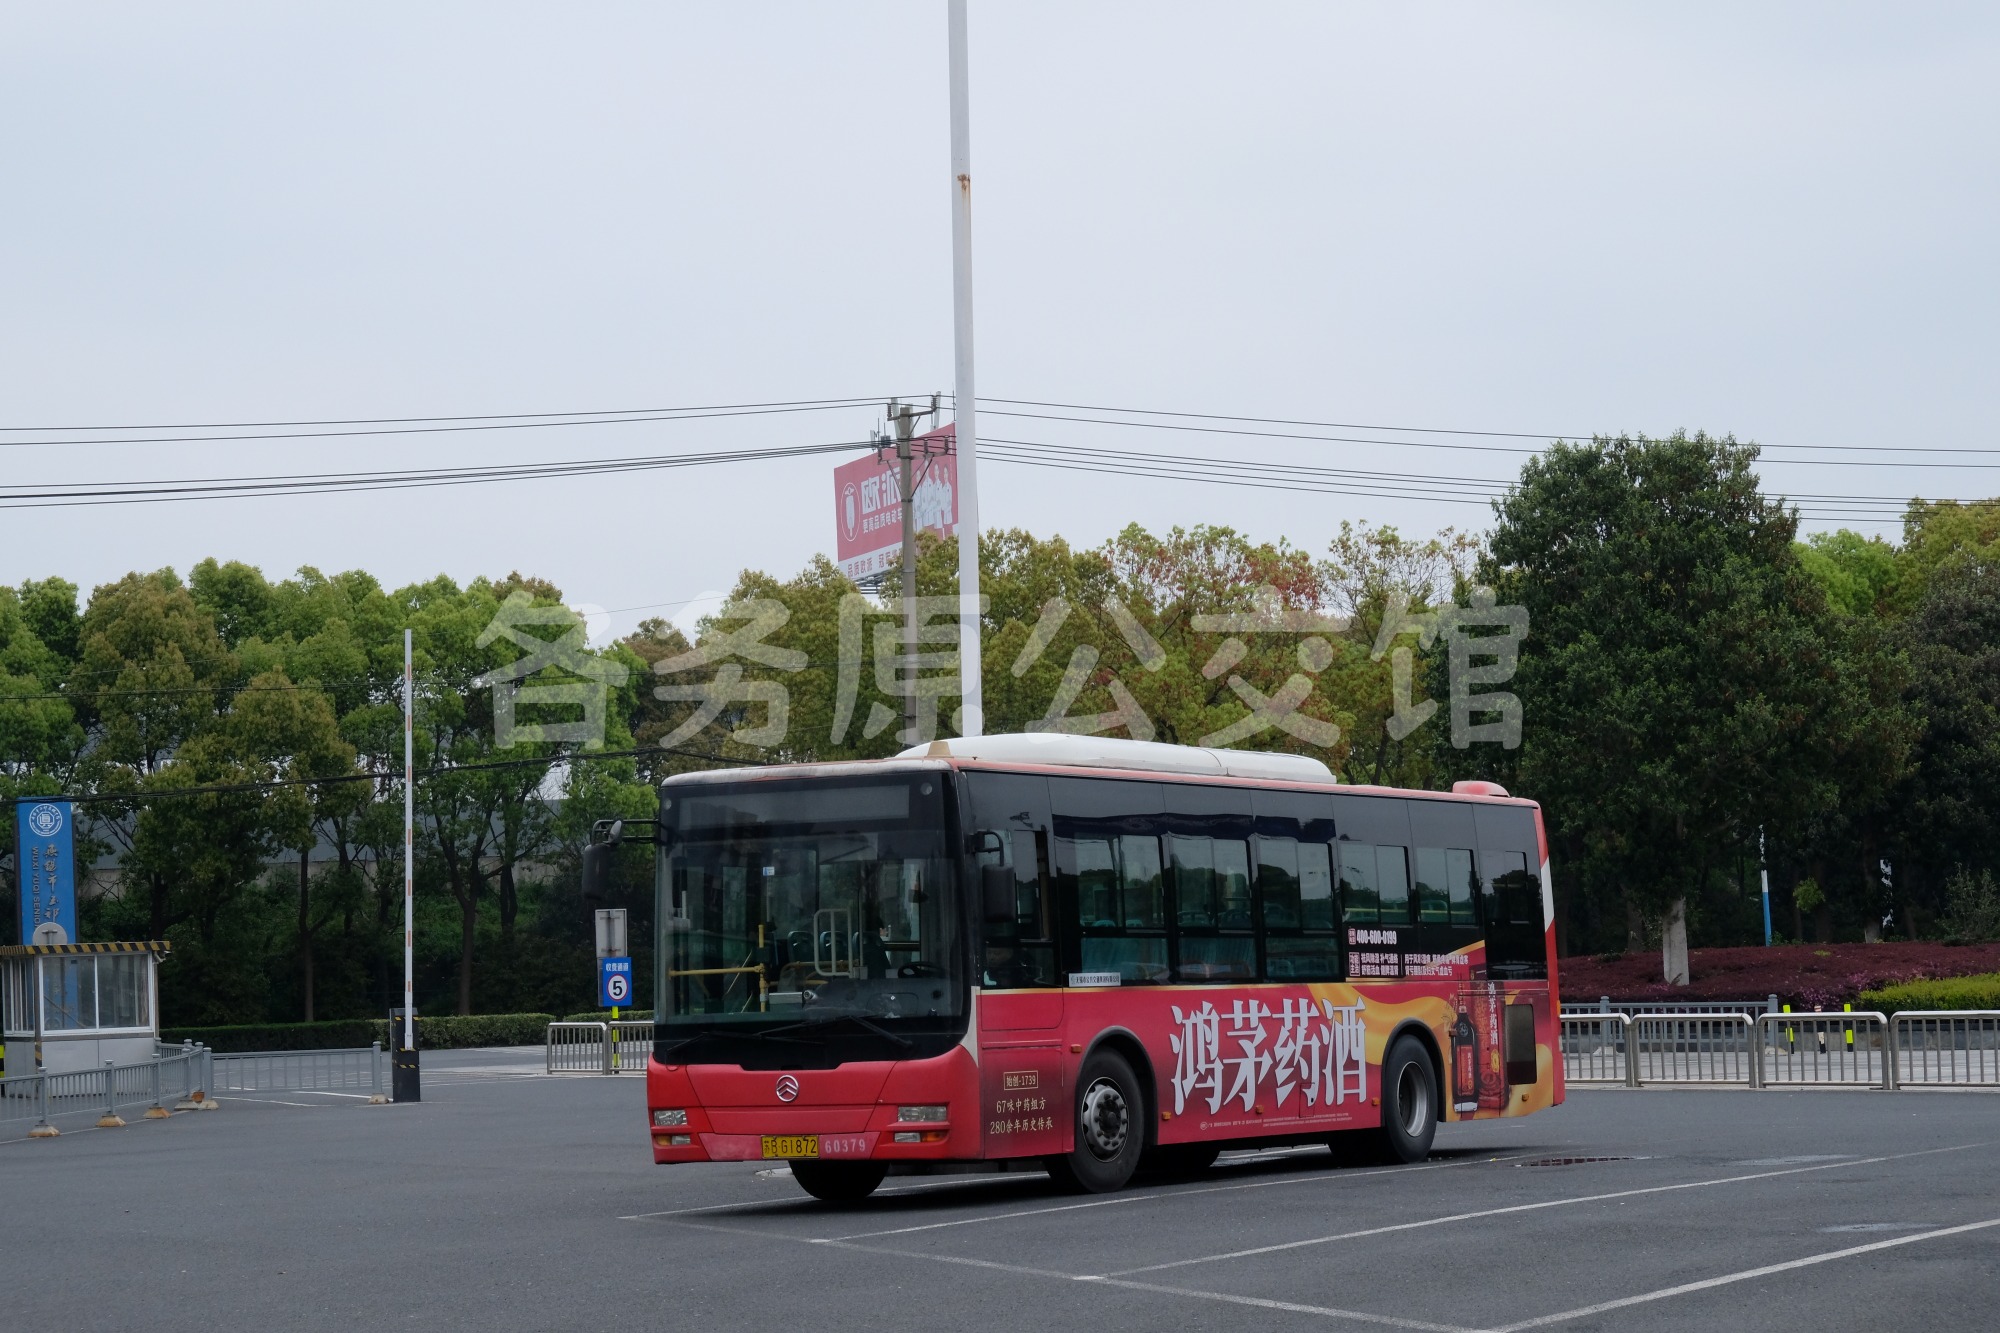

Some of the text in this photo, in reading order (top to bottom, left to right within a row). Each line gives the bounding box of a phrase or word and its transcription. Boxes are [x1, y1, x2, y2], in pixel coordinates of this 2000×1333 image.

[32, 873, 41, 894] YUQI
[606, 962, 629, 972] 收费通道
[613, 981, 623, 996] 5
[1169, 996, 1367, 1115] 鸿茅药酒
[996, 1097, 1047, 1114] 67味中药组方
[990, 1116, 1054, 1134] 280余年历史传承
[824, 1138, 866, 1154] 60379
